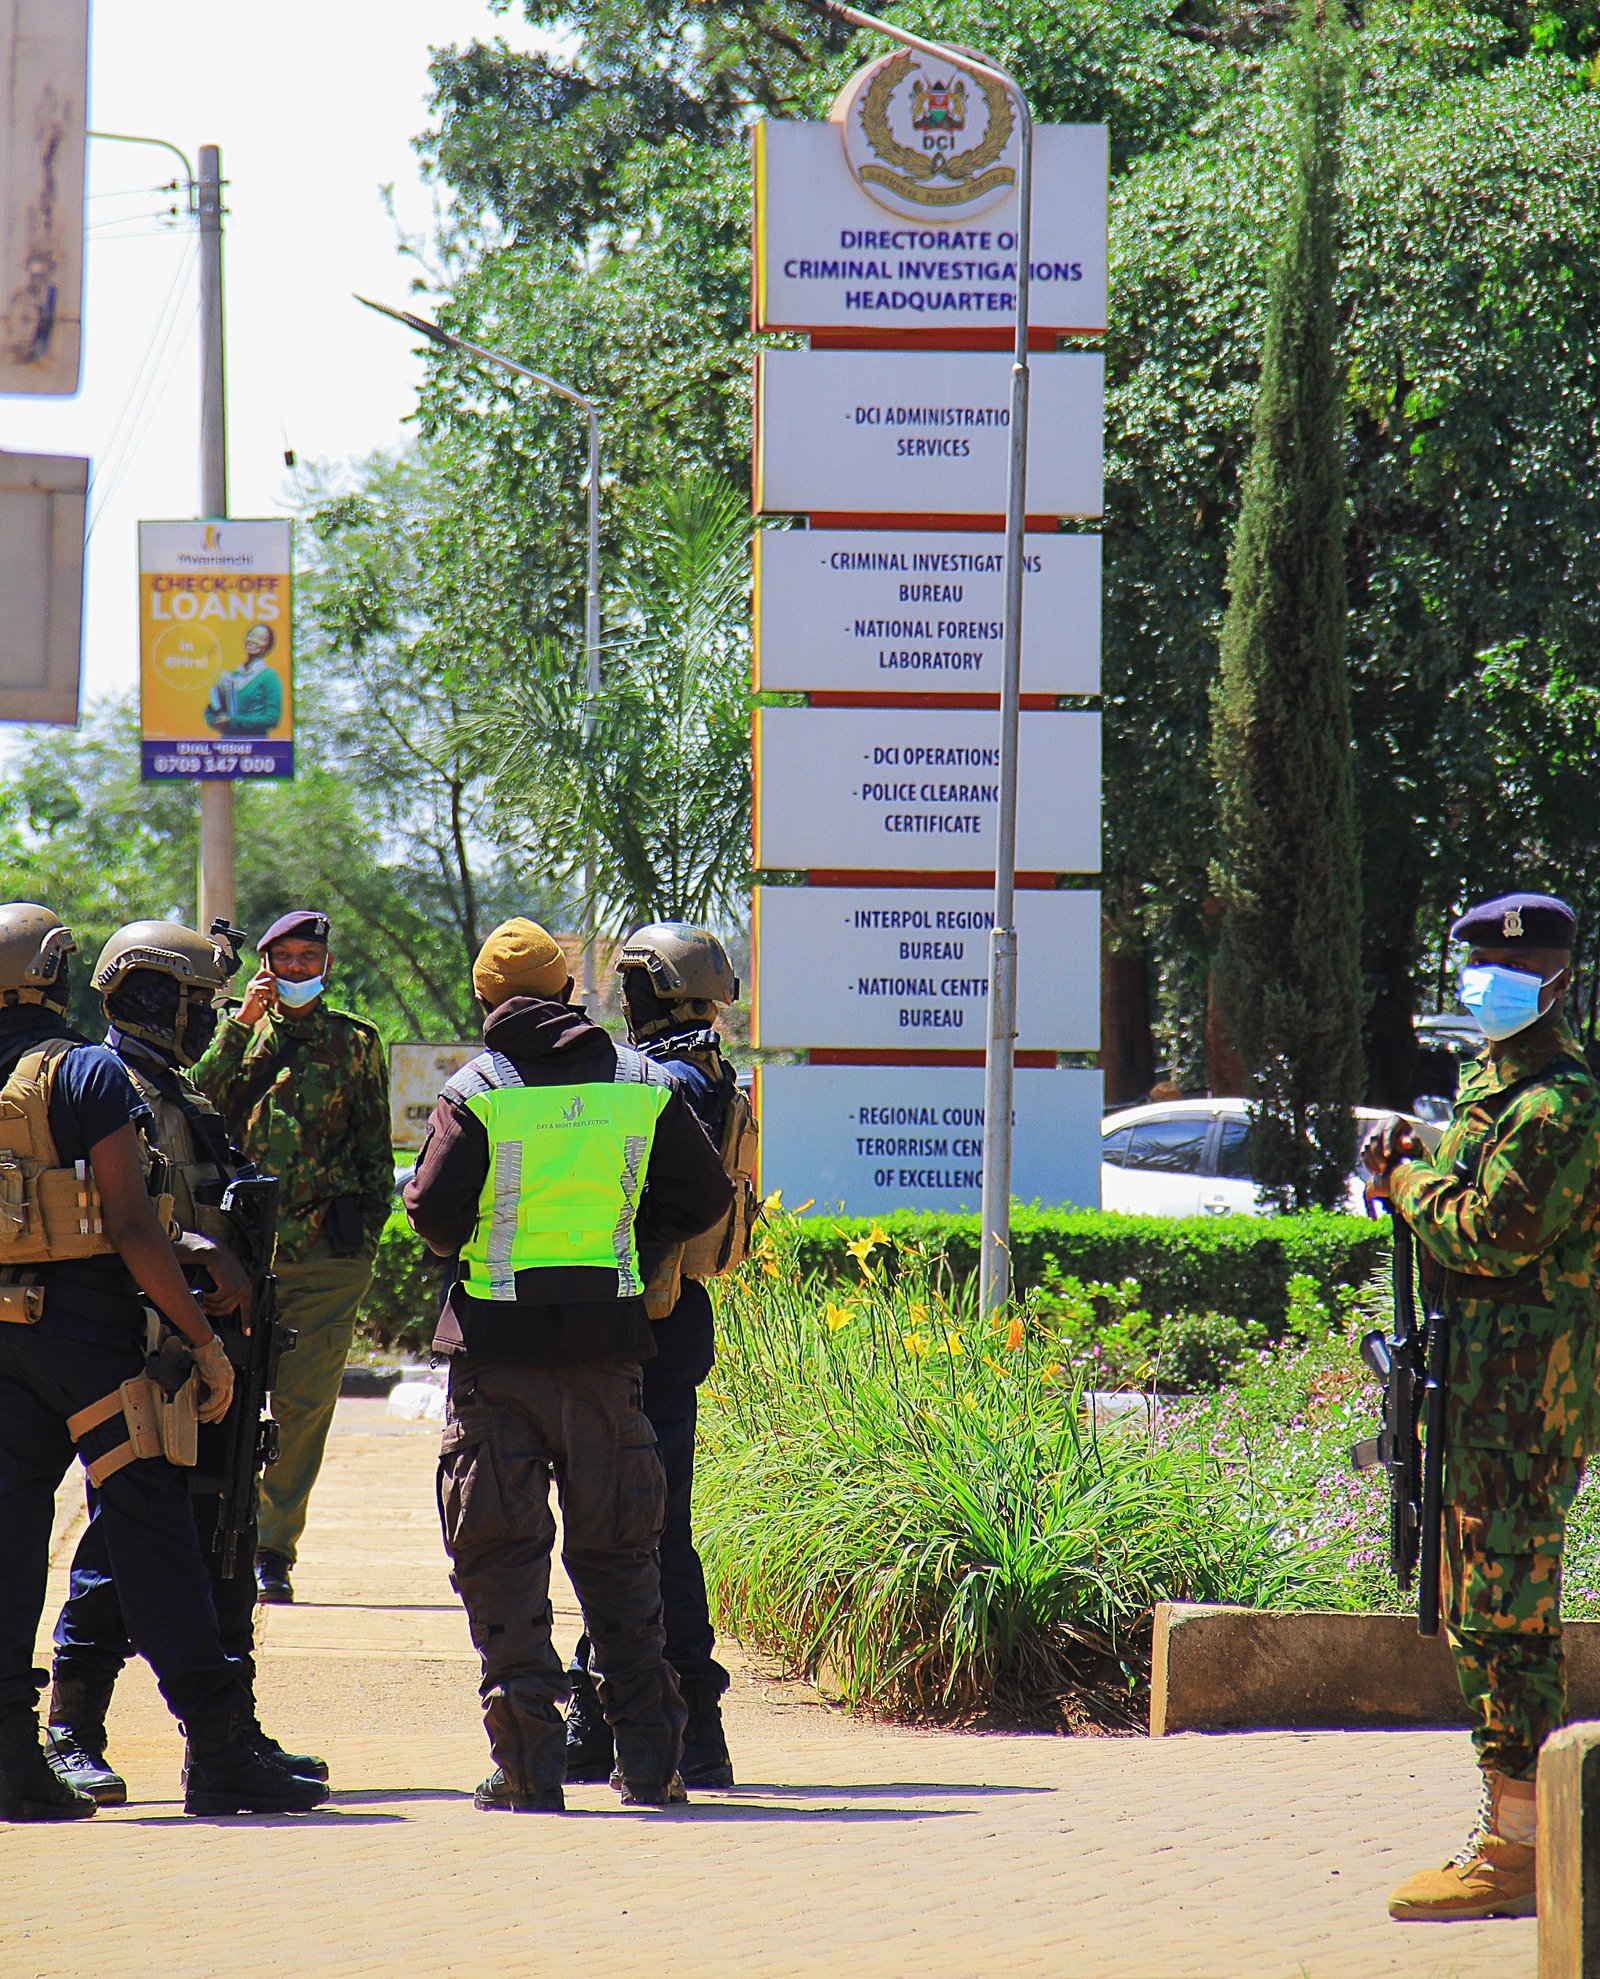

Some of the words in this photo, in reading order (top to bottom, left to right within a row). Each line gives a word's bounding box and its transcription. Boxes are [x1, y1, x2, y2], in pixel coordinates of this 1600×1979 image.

[923, 135, 955, 150] DCI
[840, 231, 991, 250] DIRECTORATE
[997, 232, 1018, 250] O
[784, 260, 892, 280] CRIMINAL
[898, 262, 1082, 281] INVESTIGAIONS
[845, 291, 1017, 312] HEADQUARTER
[855, 407, 880, 425] DCI
[885, 407, 1010, 427] ADMINISTRATIO
[896, 439, 970, 457] SERVICES
[830, 553, 908, 572] CRIMINAL
[912, 554, 1042, 573] INVESTIGATNS
[151, 576, 278, 592] CHECK-OFF
[899, 585, 963, 602] BUREAU
[151, 591, 280, 620] LOANS
[854, 620, 932, 638] NATIONAL
[937, 622, 1004, 639] FORENSI
[879, 651, 983, 670] LABORATORY
[239, 755, 275, 773] 000
[873, 747, 898, 765] DCI
[862, 784, 916, 802] POLICE
[920, 785, 999, 803] CLEARANC
[884, 815, 981, 833] CERTIFICATE
[855, 911, 931, 929] INTERPOL
[936, 912, 995, 930] REGION
[899, 942, 963, 960] BUREAU
[858, 978, 937, 997] NATIONAL
[899, 1009, 963, 1027] BUREAU
[859, 1107, 938, 1126] REGIONAL
[857, 1138, 948, 1156] TERORRISM
[874, 1169, 895, 1187] OF
[899, 1169, 984, 1189] EXCELLENC
